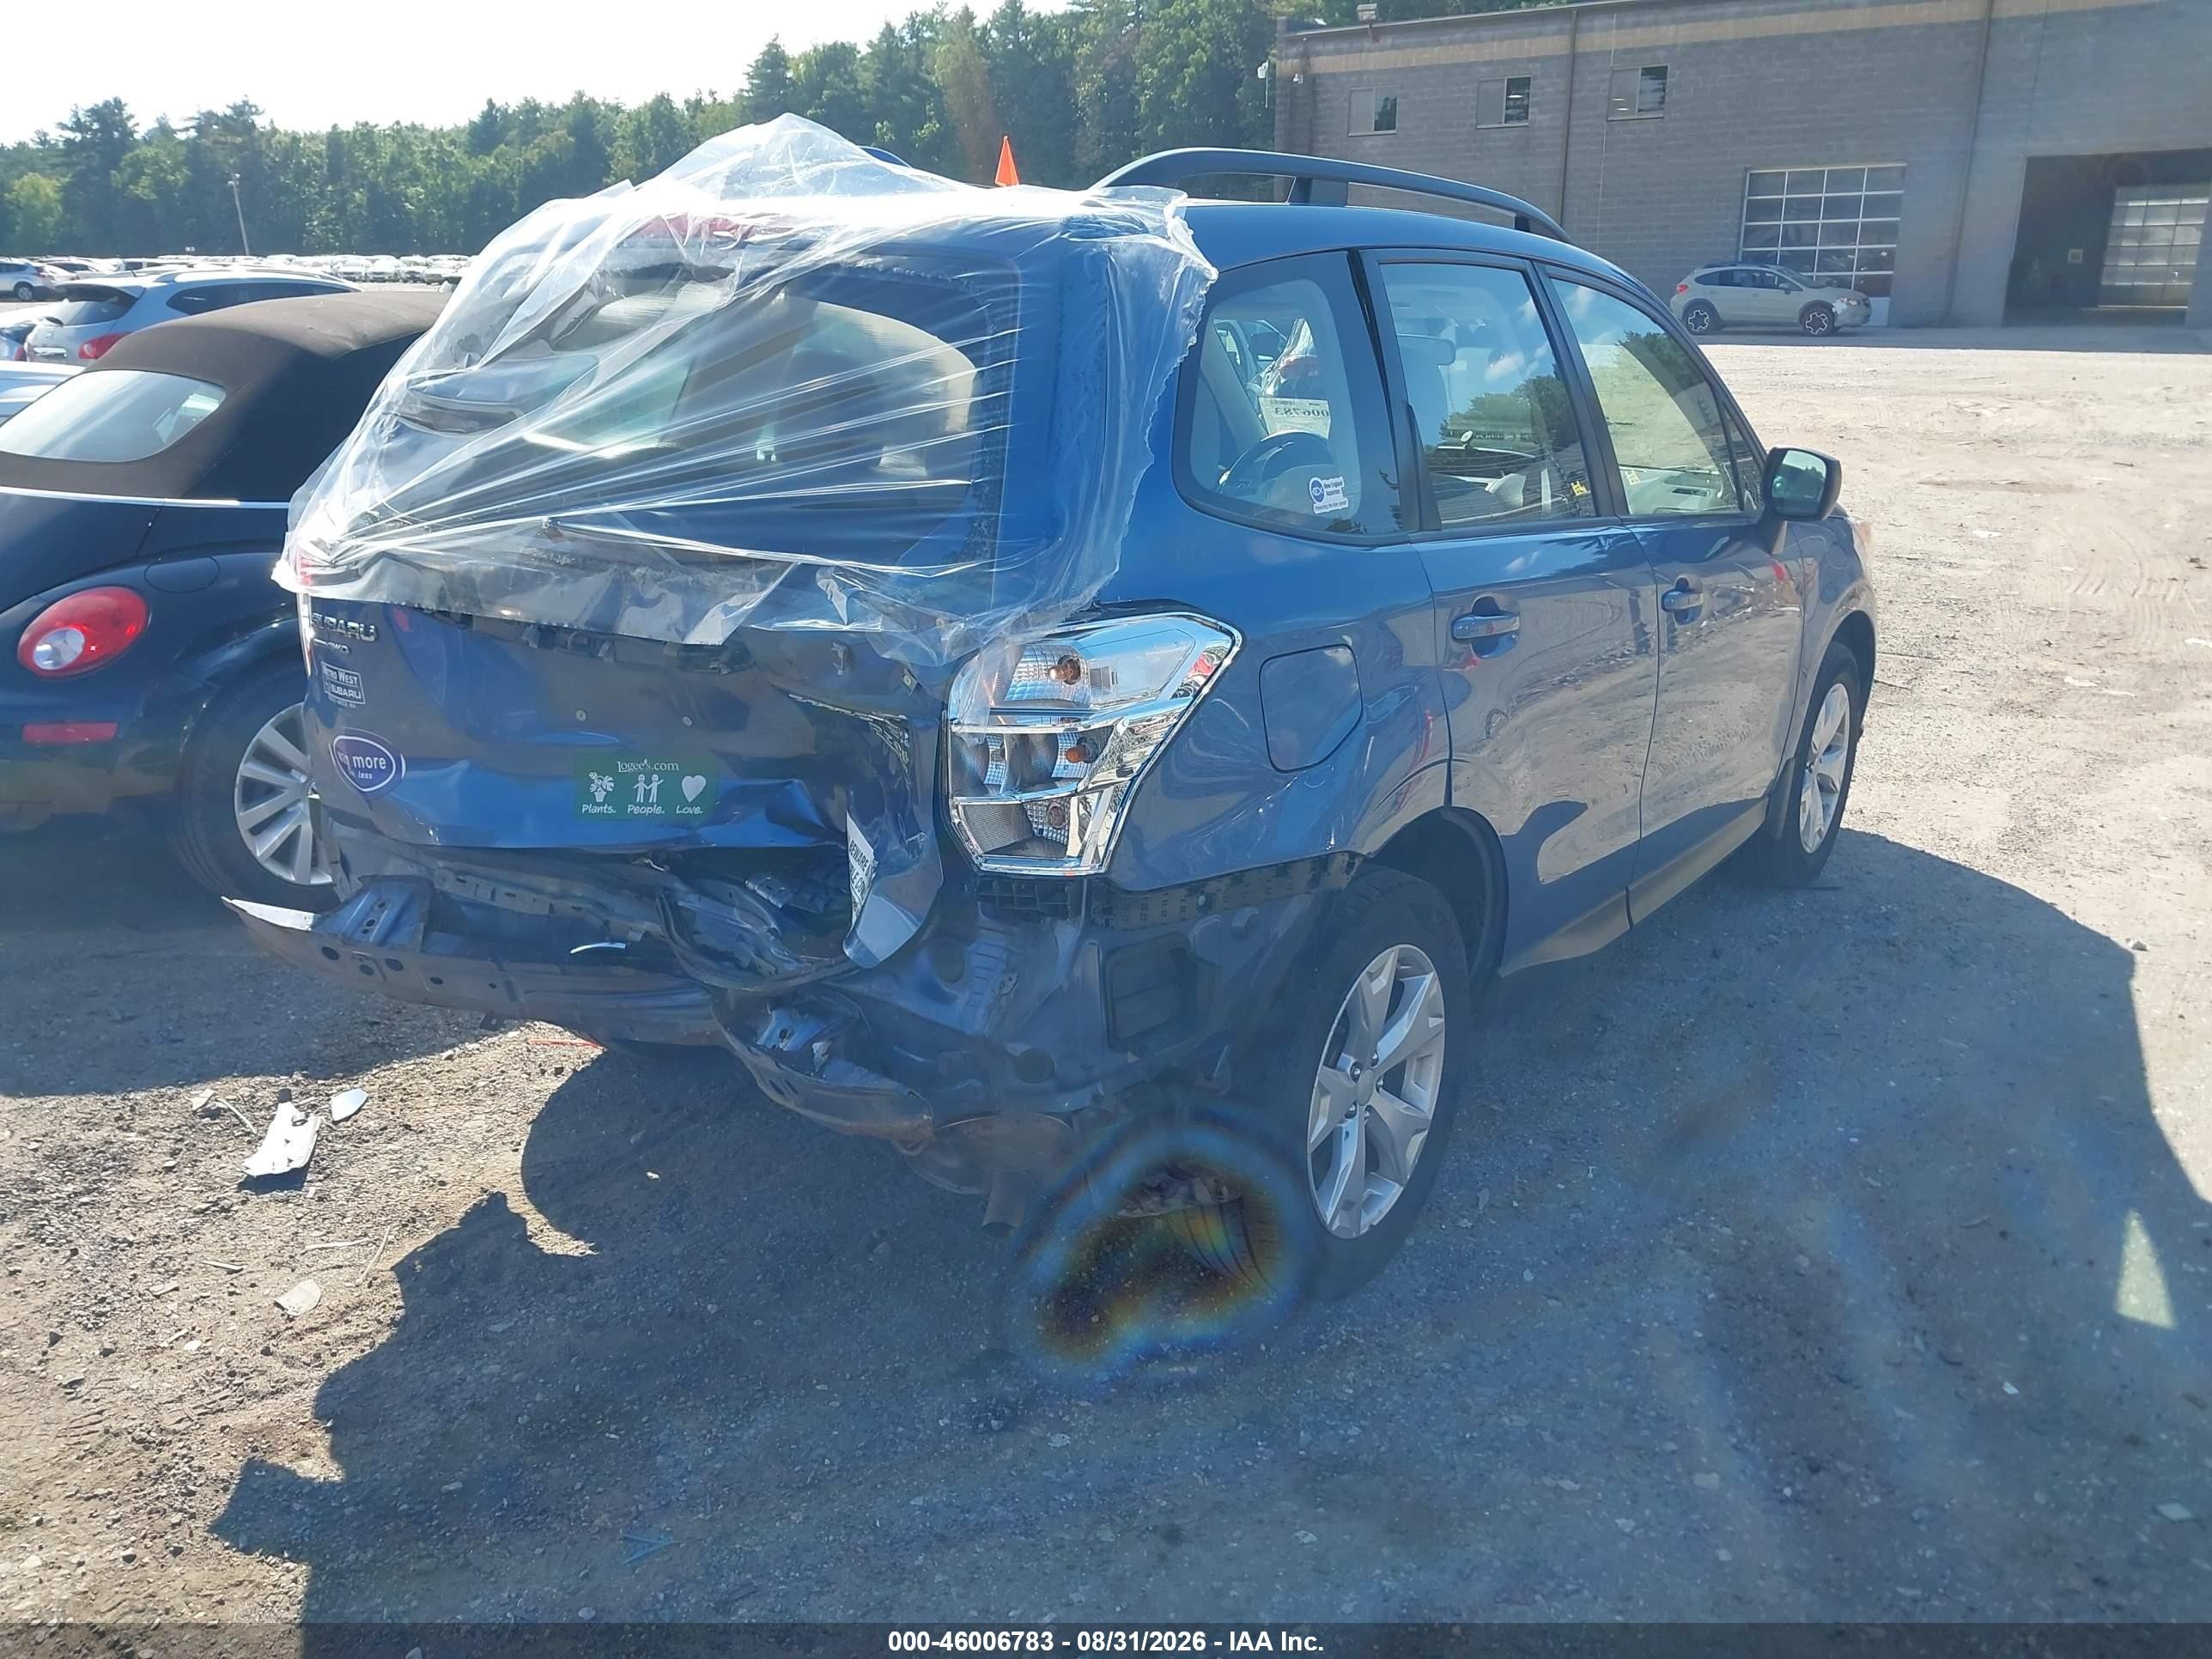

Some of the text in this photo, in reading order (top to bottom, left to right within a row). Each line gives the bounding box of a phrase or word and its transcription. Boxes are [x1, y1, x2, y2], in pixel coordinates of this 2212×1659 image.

[311, 612, 378, 641] SUBARU
[330, 684, 362, 699] SUBARU
[352, 756, 386, 770] more
[617, 758, 679, 773] Logee's.com
[357, 770, 374, 779] less
[581, 804, 703, 816] Plants. People. Love.
[848, 840, 869, 872] BEWARE
